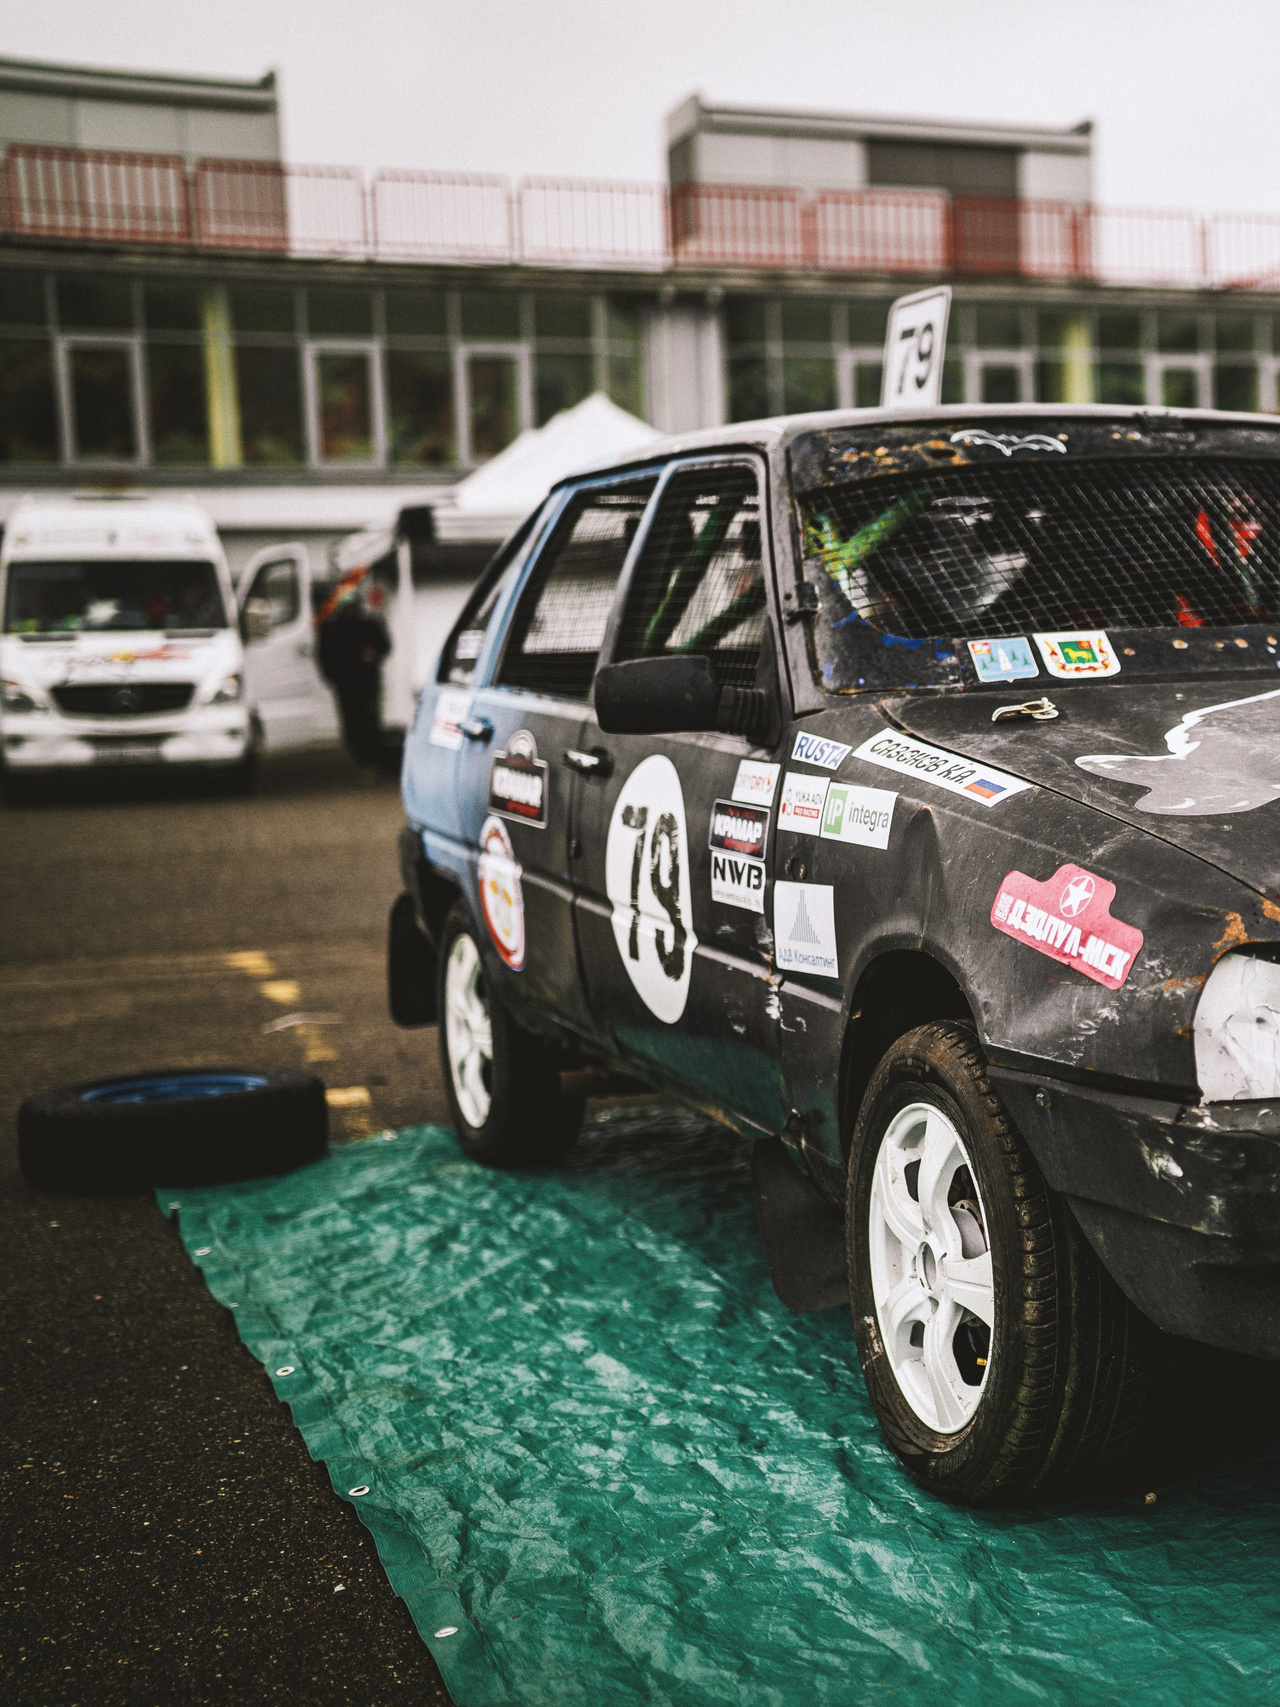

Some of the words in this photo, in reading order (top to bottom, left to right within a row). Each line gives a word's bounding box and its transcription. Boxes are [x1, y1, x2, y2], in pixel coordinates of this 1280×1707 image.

[899, 322, 934, 395] 79
[794, 735, 849, 768] RUSTA
[869, 738, 944, 772] САЗОНОВ
[827, 797, 843, 827] IP
[849, 801, 890, 832] integra
[713, 856, 763, 890] NWB
[621, 804, 688, 982] 79
[1006, 898, 1131, 981] ДЭДПУЛ-МСК
